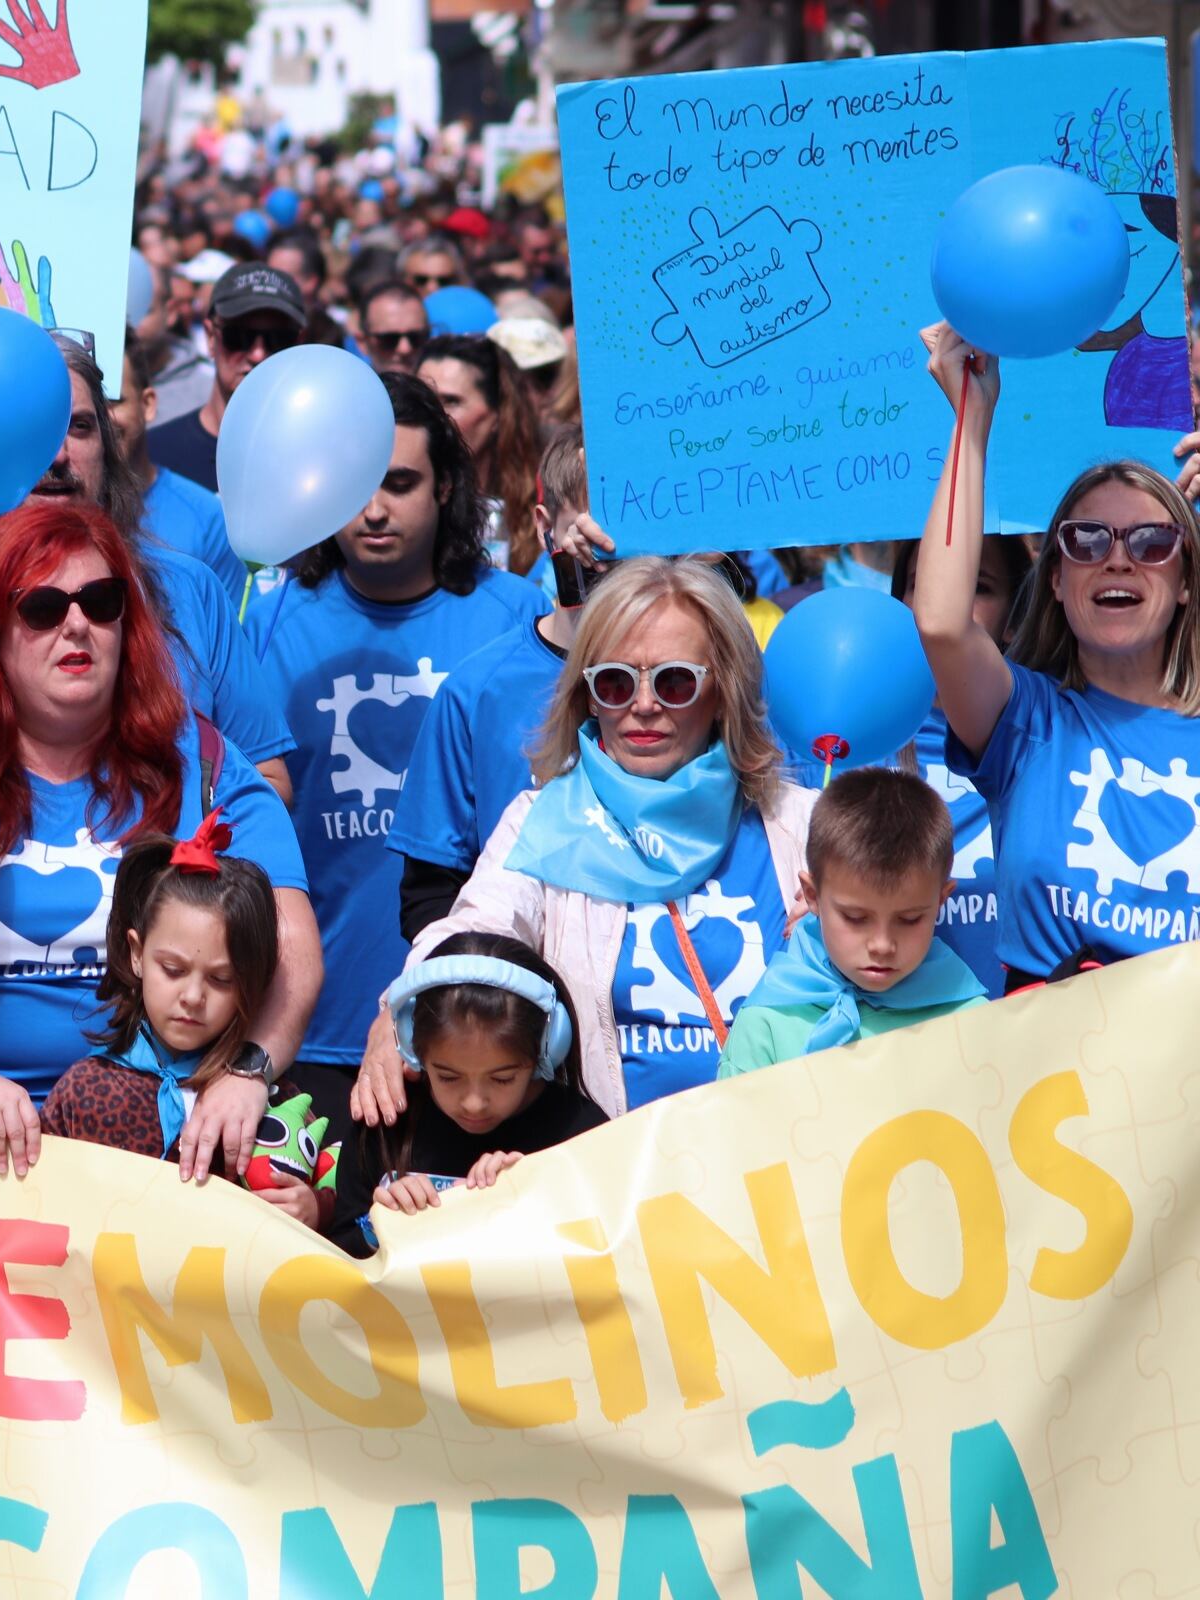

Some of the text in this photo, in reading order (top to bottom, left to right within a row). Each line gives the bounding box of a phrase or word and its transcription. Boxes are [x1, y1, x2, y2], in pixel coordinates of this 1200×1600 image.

[595, 84, 643, 140] El
[826, 64, 954, 120] necesita
[603, 122, 960, 192] todo tipo de mentes
[689, 241, 757, 276] Dia
[719, 294, 814, 354] autismo
[739, 284, 774, 315] del
[667, 427, 733, 460] Pero
[837, 386, 911, 430] todo
[835, 450, 912, 493] COMO
[320, 808, 396, 840] TEACO
